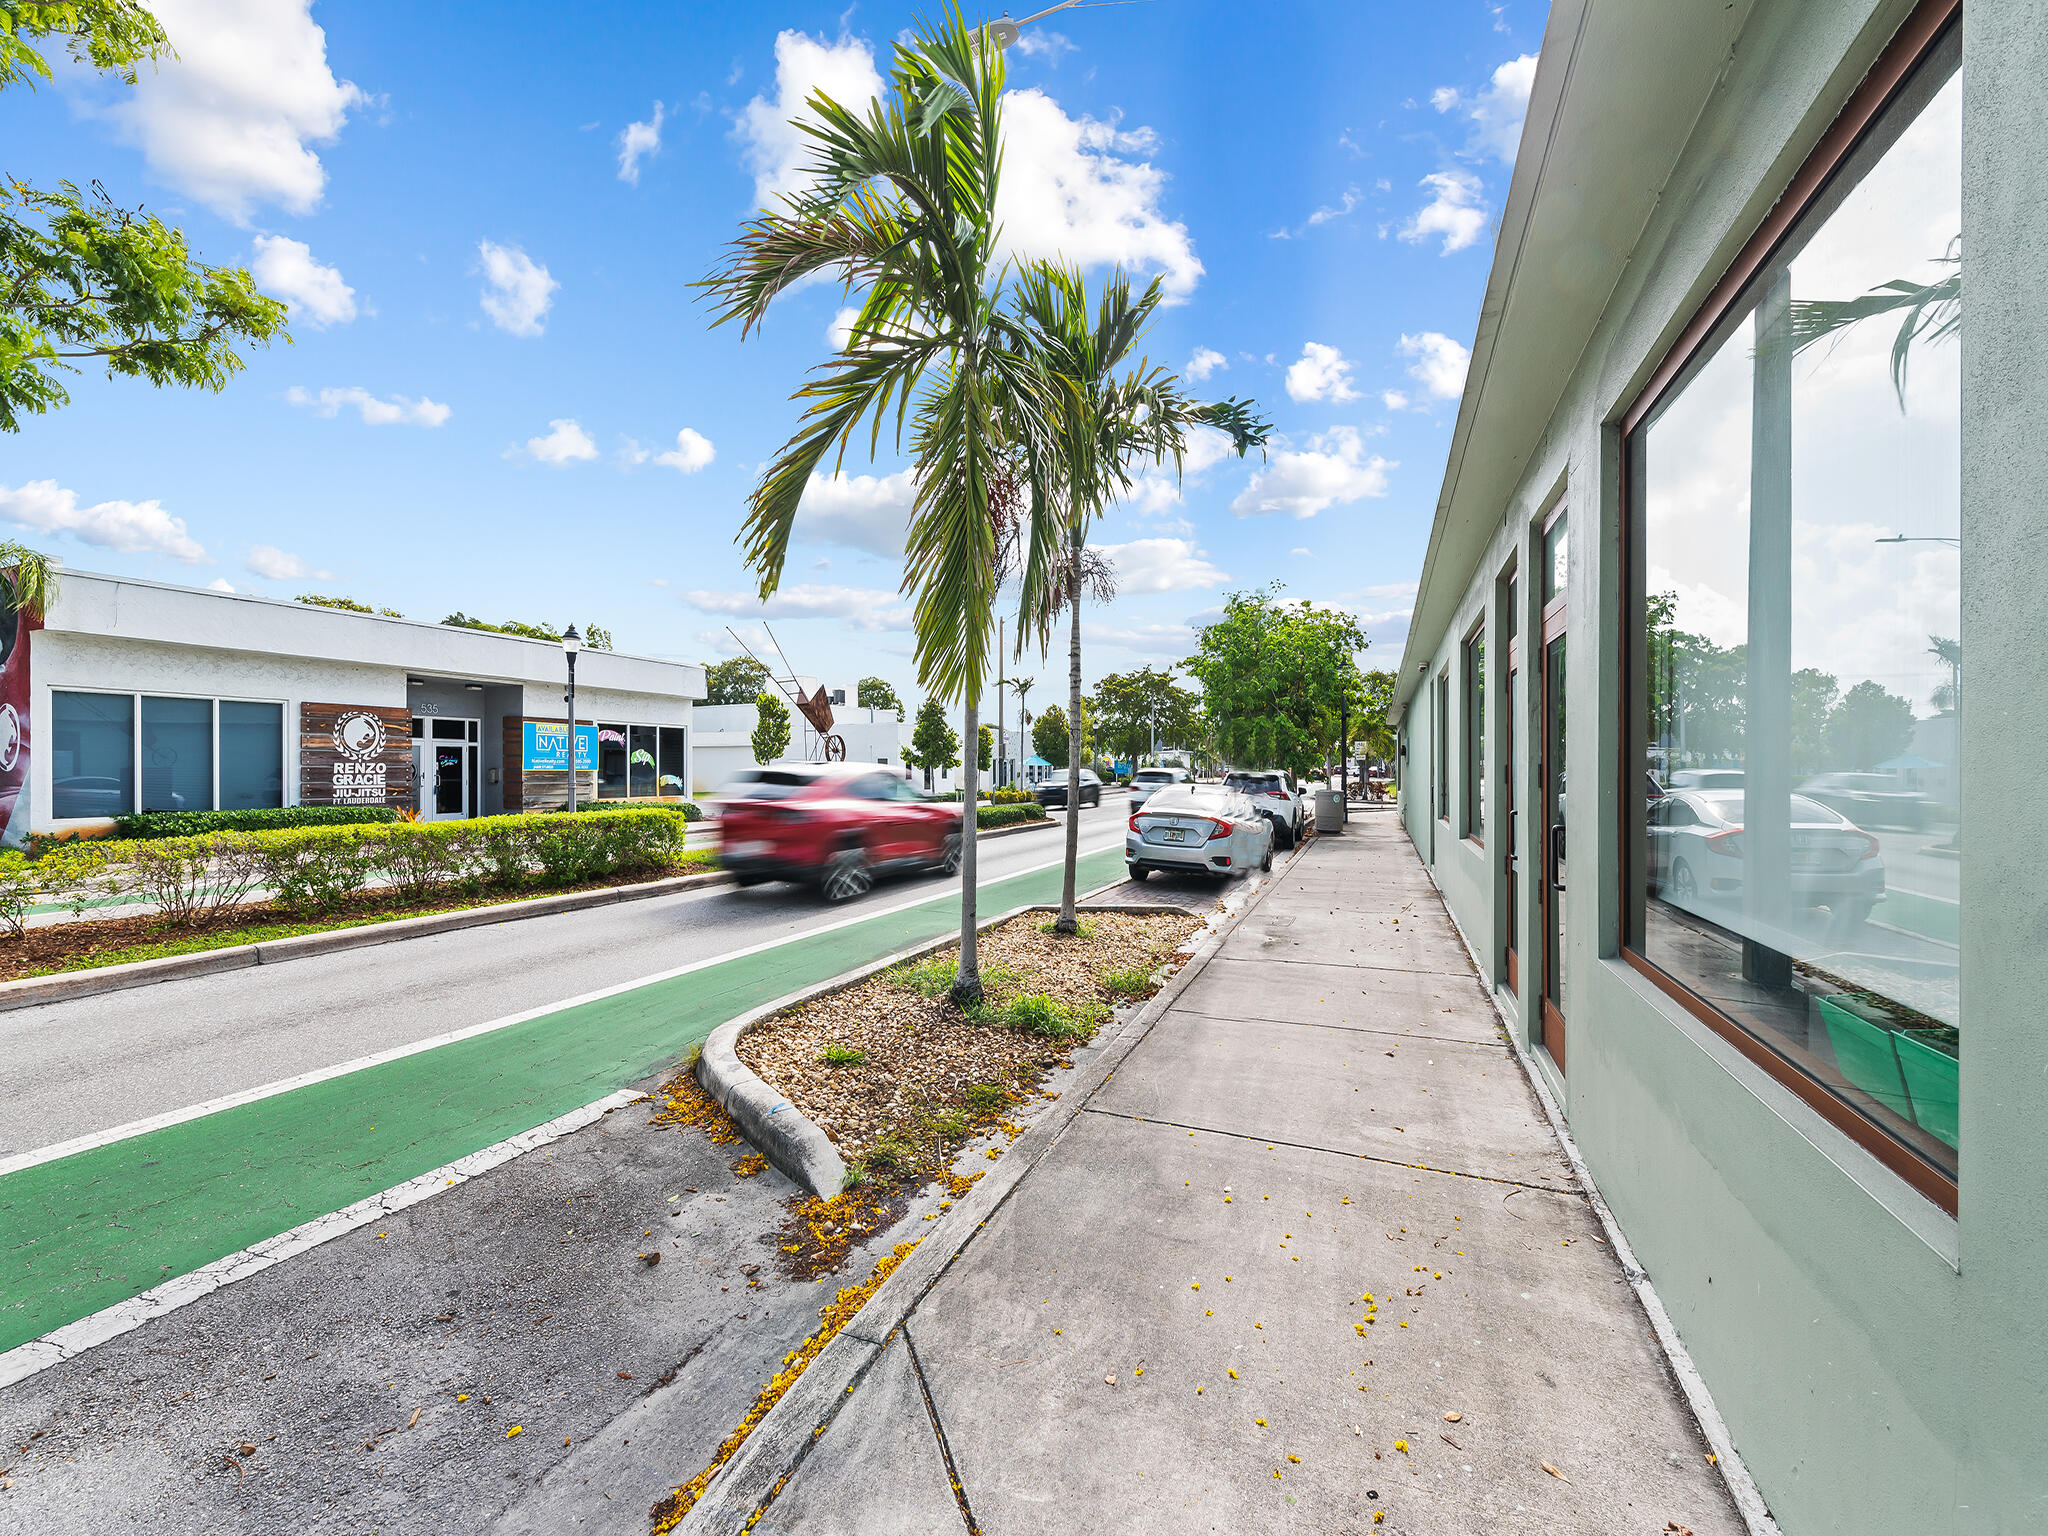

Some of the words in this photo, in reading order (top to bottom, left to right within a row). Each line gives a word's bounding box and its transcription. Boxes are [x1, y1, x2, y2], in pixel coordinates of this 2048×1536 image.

[421, 703, 438, 713] 535
[333, 762, 387, 774] RENZO
[332, 773, 386, 785] GRACIE
[332, 788, 386, 798] JIU-JITSU
